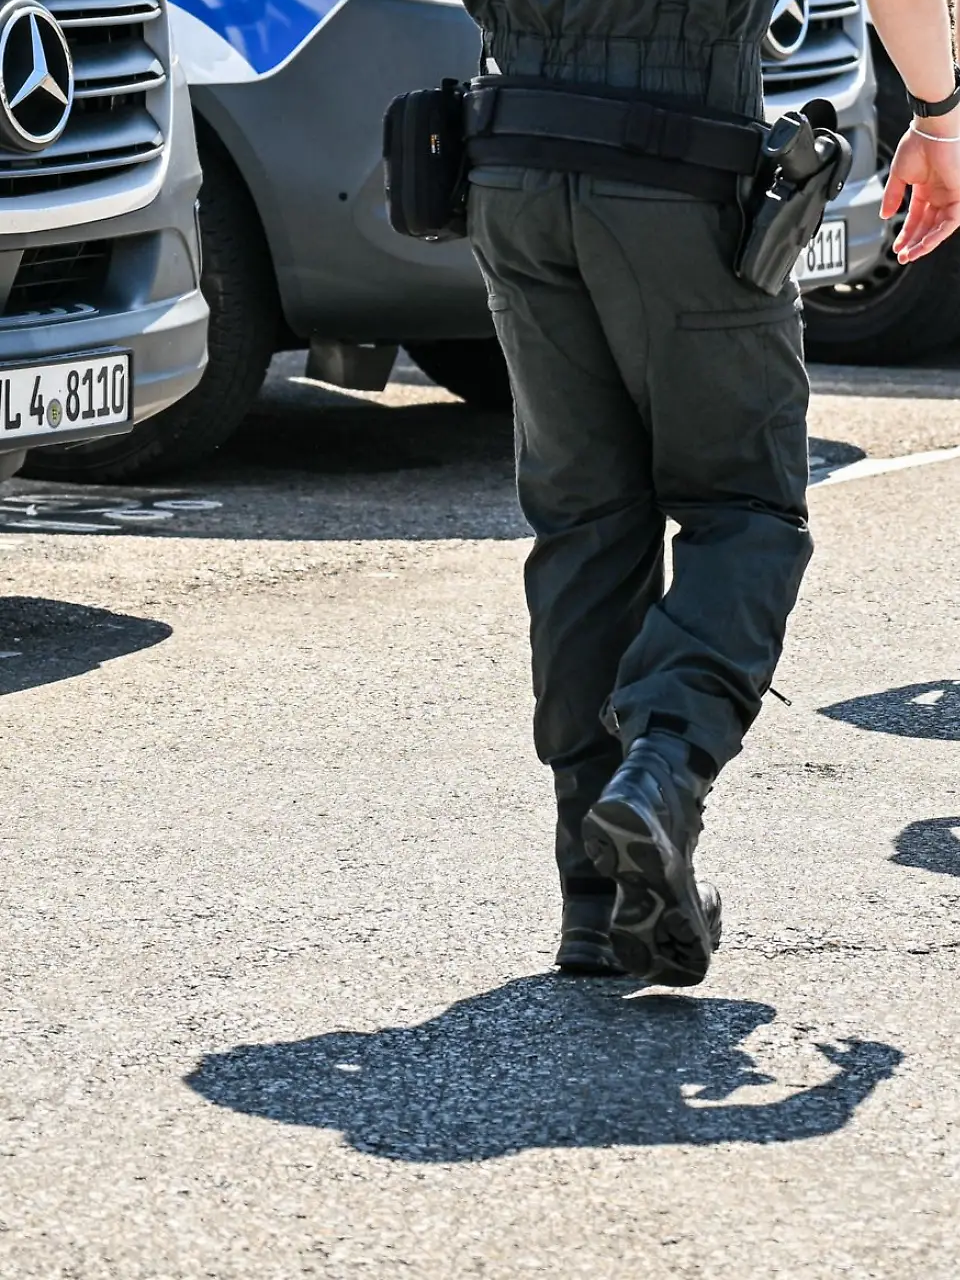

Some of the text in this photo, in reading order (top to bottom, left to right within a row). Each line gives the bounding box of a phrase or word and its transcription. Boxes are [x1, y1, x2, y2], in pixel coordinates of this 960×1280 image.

[807, 228, 843, 272] 8111
[0, 363, 125, 430] L 4 8110
